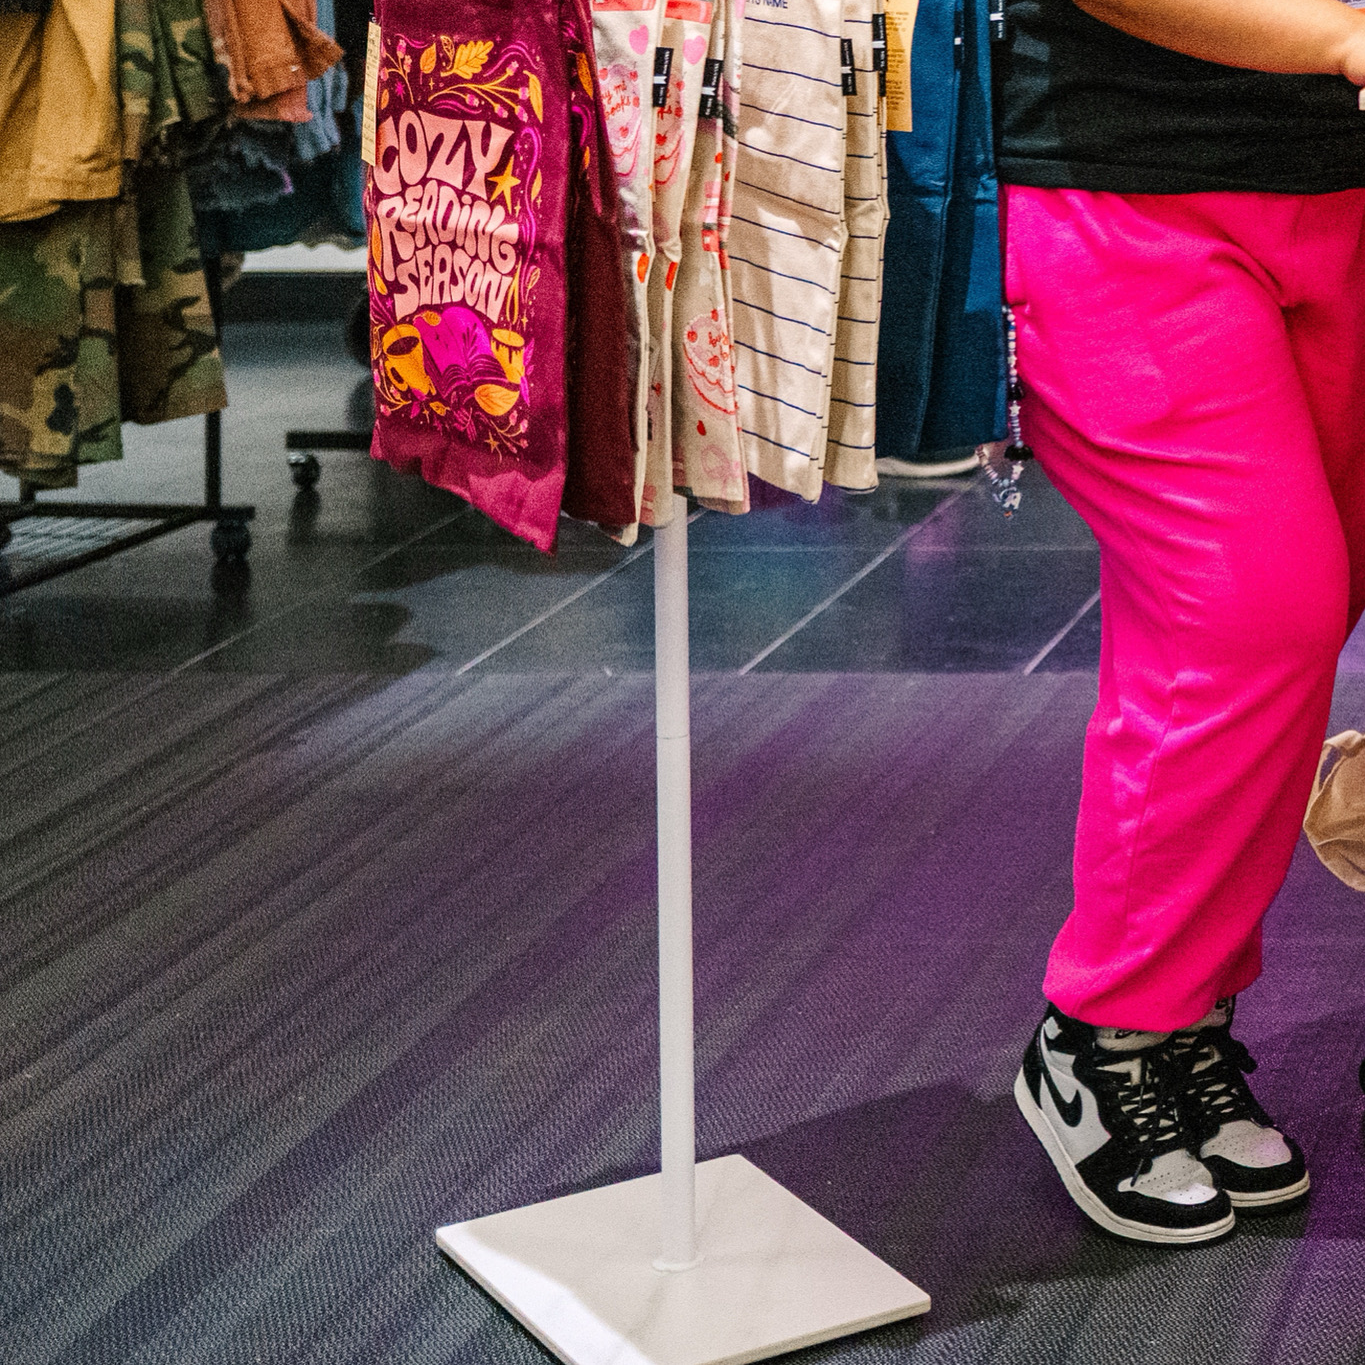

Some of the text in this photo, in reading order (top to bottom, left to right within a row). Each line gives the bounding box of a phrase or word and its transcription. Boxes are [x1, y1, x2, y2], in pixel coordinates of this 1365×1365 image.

[373, 110, 515, 220] COZY
[377, 180, 519, 282] READING
[394, 244, 513, 324] SEASON
